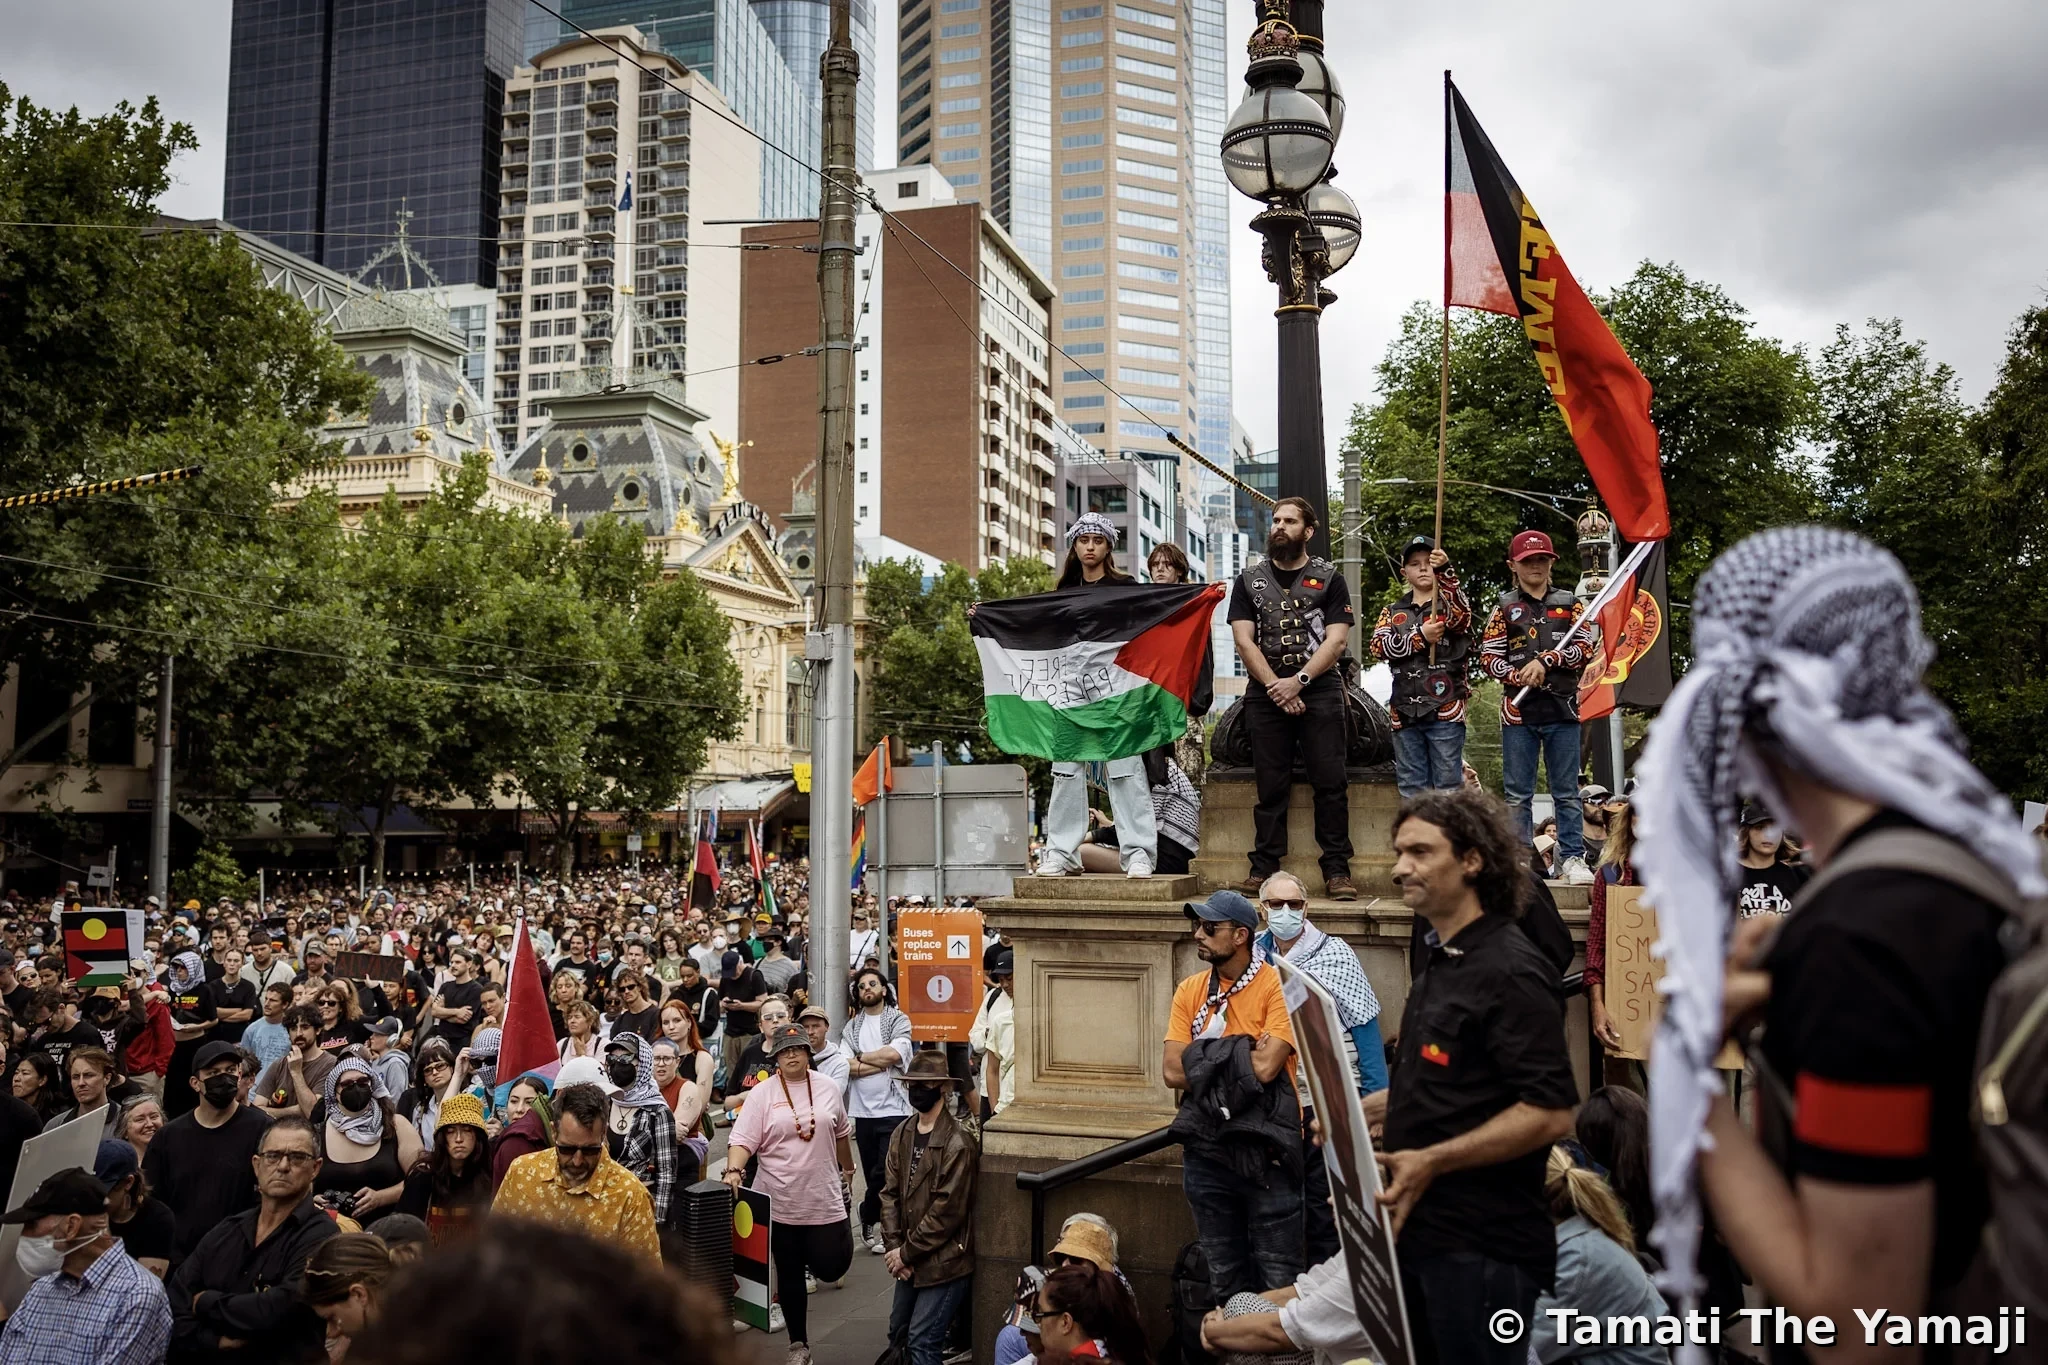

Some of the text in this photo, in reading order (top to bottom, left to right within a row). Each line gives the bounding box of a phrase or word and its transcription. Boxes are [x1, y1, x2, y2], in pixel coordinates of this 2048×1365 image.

[1741, 883, 1783, 899] NOT A
[1740, 894, 1771, 909] ATE
[903, 928, 934, 938] Buses
[903, 940, 942, 951] replace
[903, 951, 933, 960] trains
